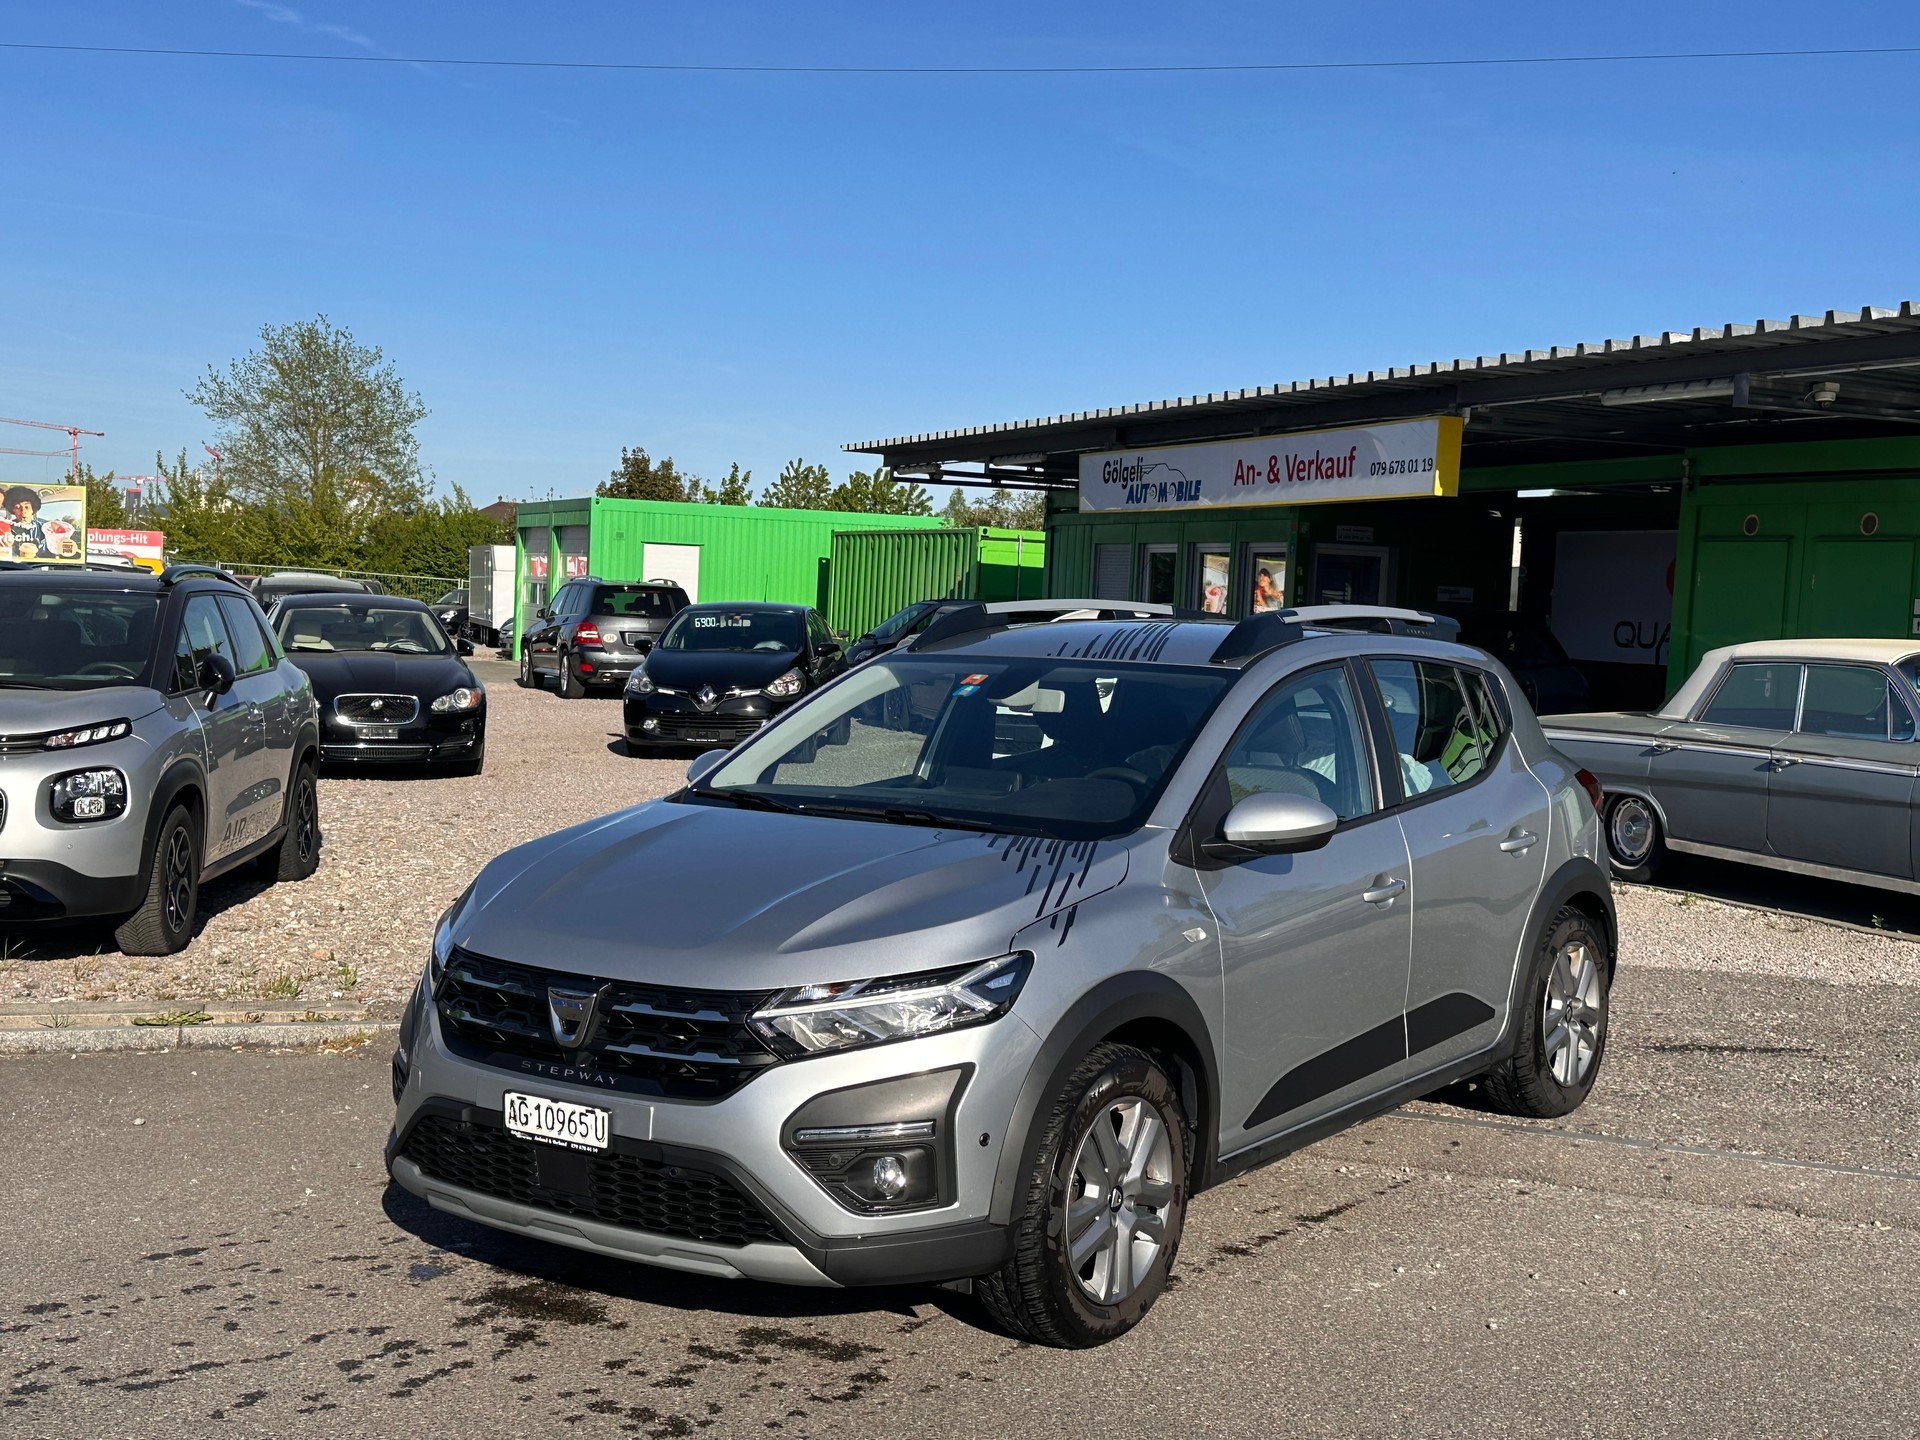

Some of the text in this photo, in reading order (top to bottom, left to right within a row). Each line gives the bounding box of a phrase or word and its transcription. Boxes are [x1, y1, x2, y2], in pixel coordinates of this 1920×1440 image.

[1102, 456, 1143, 490] Gölgeli
[1233, 446, 1357, 486] An- & Verkauf
[1370, 457, 1434, 477] 079 678 01 19
[1125, 480, 1202, 504] AUTOMOBILE
[521, 1060, 618, 1085] STEPWAY
